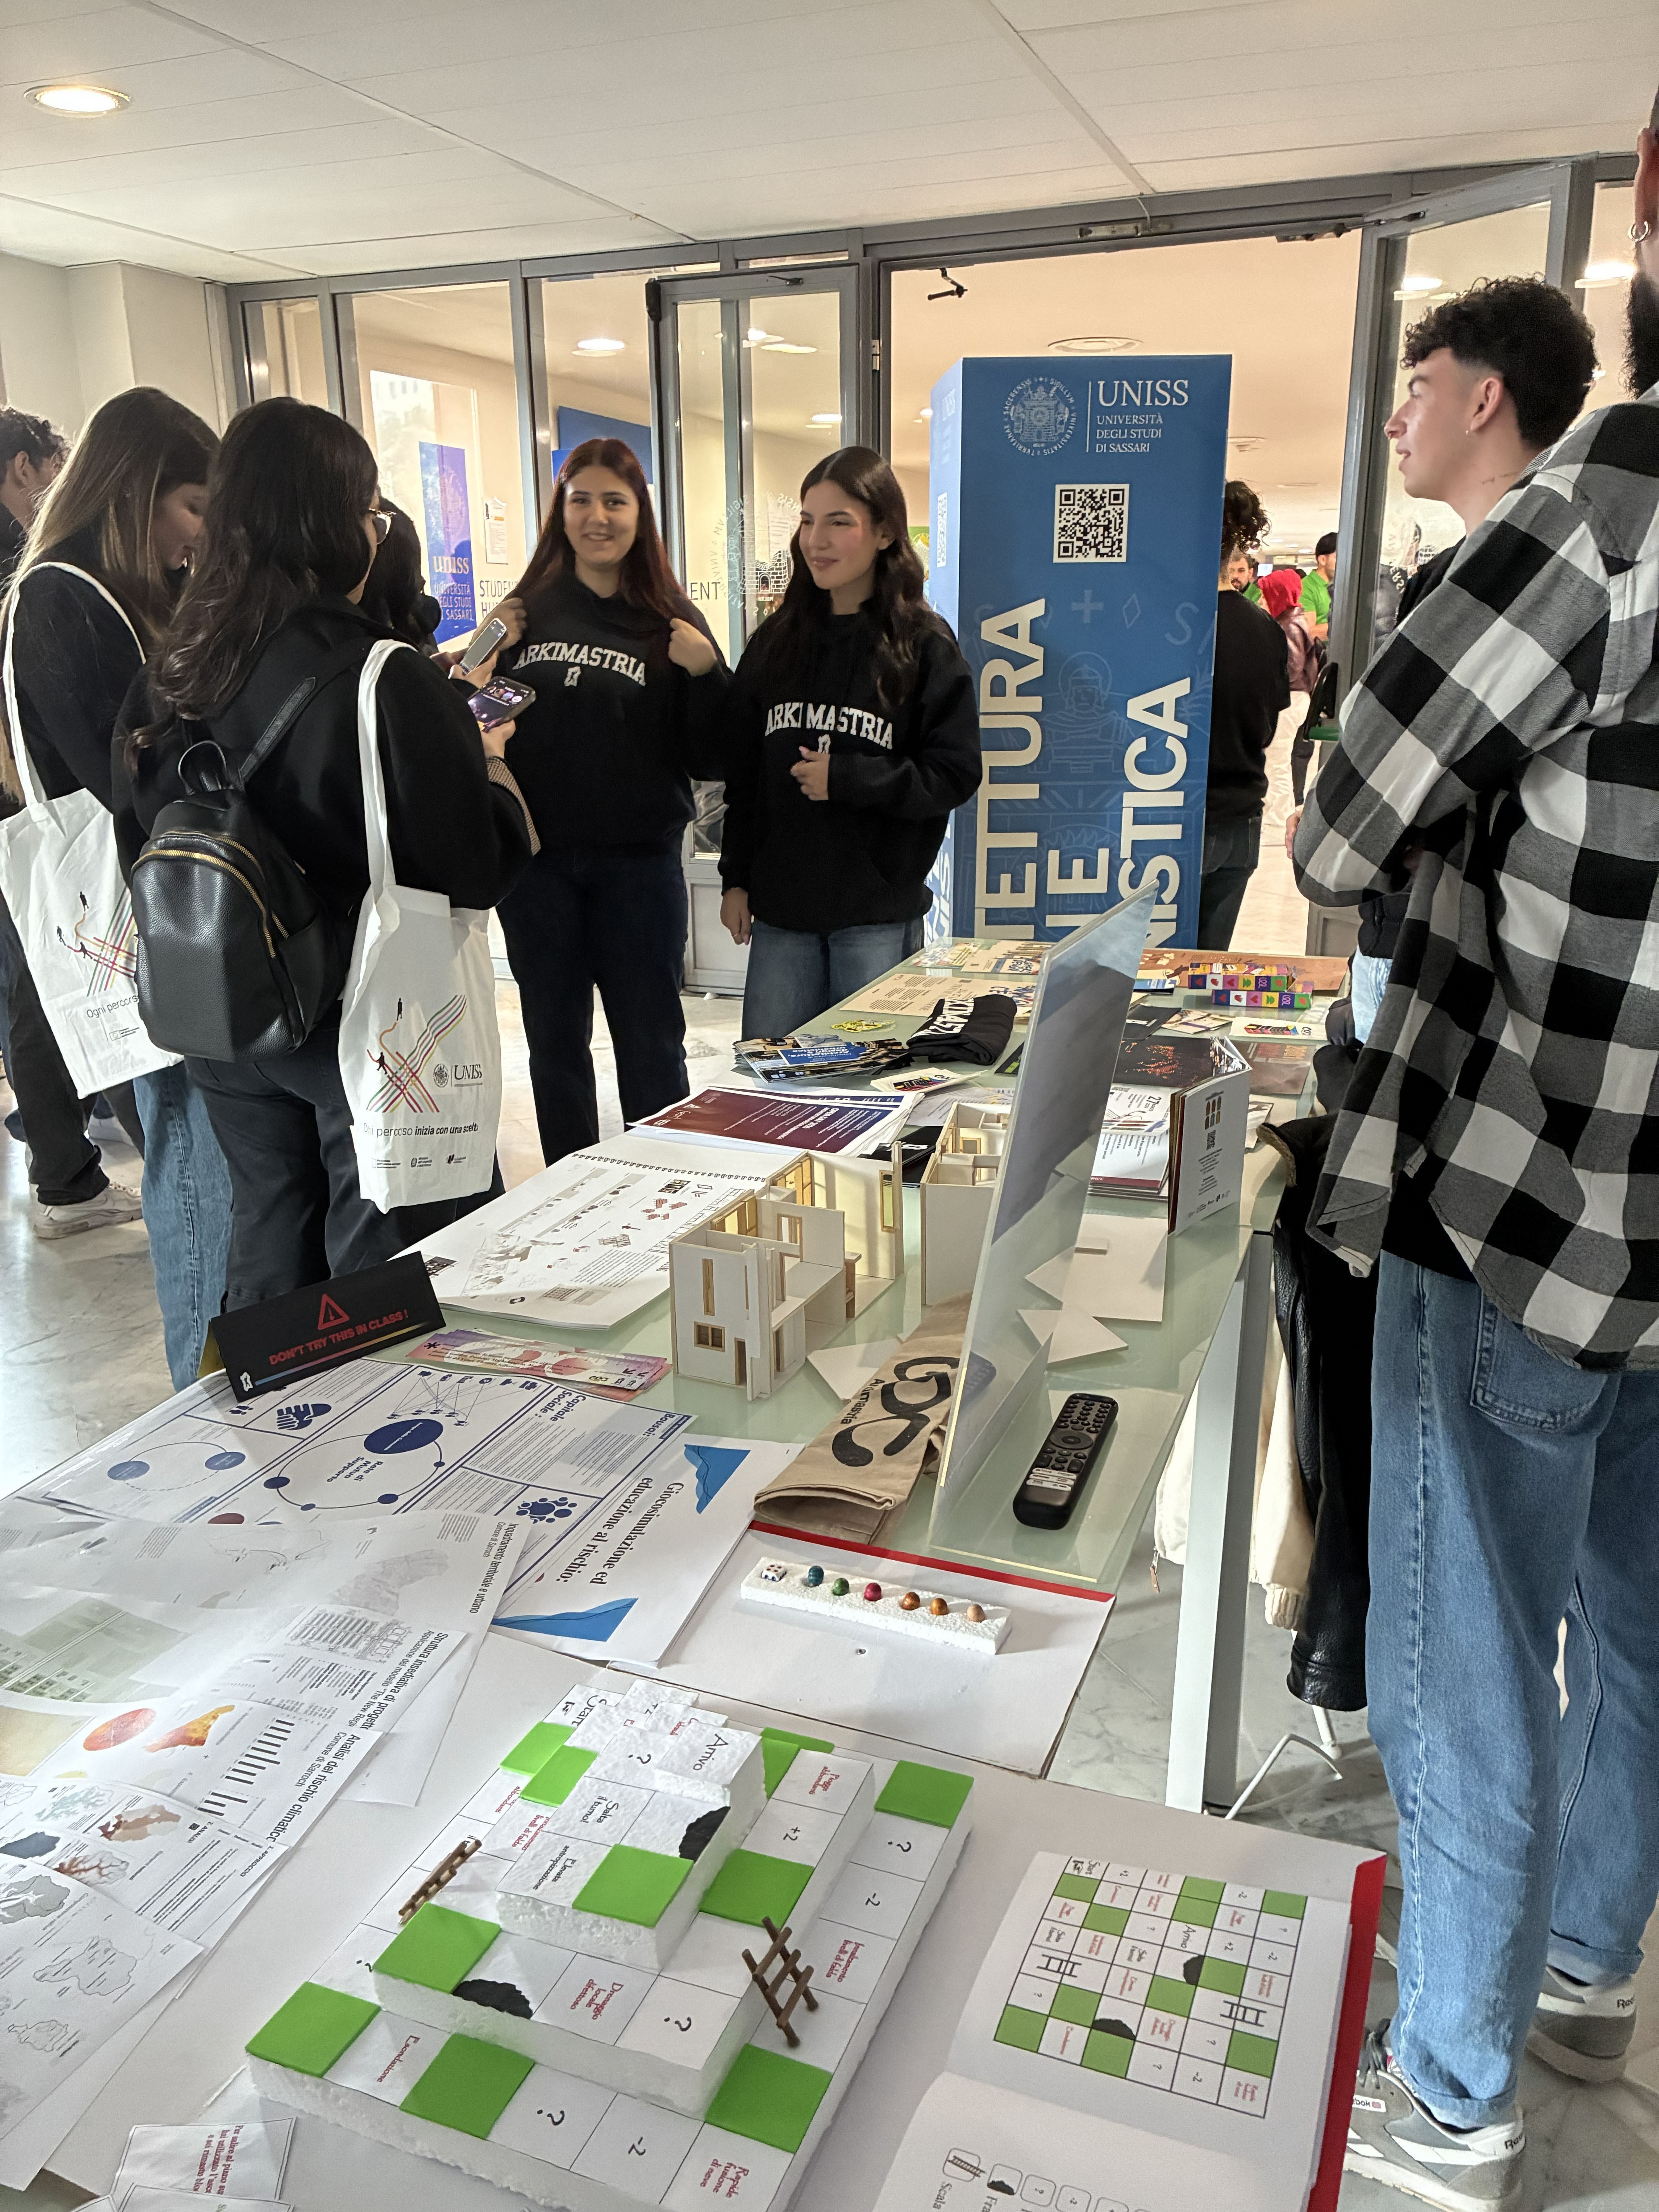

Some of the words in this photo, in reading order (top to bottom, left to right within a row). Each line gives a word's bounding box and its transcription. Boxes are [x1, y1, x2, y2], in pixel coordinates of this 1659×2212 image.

[1098, 379, 1189, 407] UNISS
[1097, 412, 1163, 425] UNIVERSITÀ
[1096, 428, 1128, 439] DEGLI
[1130, 428, 1162, 438] STUDI
[1096, 443, 1107, 453] DI
[1109, 442, 1150, 453] SASSARI
[434, 582, 471, 595] UNIVERSITÀ
[454, 597, 472, 608] STUDI
[512, 641, 646, 687] ARKIMASTRIA
[764, 702, 893, 750] ARKIMASTRIA
[974, 598, 1046, 939] TETTURA
[86, 1007, 106, 1019] Ogni
[106, 994, 140, 1015] percors
[414, 1125, 434, 1135] inizia
[436, 1126, 448, 1135] con
[449, 1125, 463, 1134] una
[269, 1345, 305, 1365] DON'T
[307, 1338, 327, 1353] TRY
[329, 1328, 355, 1345] THIS
[356, 1324, 368, 1336] IN
[369, 1311, 402, 1331] CLASS
[540, 1390, 572, 1413] Sociale
[550, 1395, 586, 1422] Capitale
[642, 1413, 676, 1437] Bousai:
[326, 1456, 365, 1482] Supporto
[344, 1460, 372, 1479] Mutuo
[363, 1460, 383, 1474] Rete
[601, 1477, 654, 1530] educazione
[592, 1531, 609, 1544] al
[604, 1482, 685, 1571] Giocosimulazione
[493, 1523, 519, 1560] Inquadramento
[481, 1561, 502, 1588] territoriale
[556, 1543, 599, 1583] rischio:
[589, 1571, 608, 1585] ed
[469, 1593, 486, 1613] urbano
[405, 1630, 434, 1659] Applicazione
[418, 1632, 449, 1659] Struttura
[397, 1657, 410, 1668] del
[391, 1656, 429, 1695] insediativa
[361, 1698, 377, 1712] New
[386, 1693, 397, 1702] di
[321, 1731, 347, 1756] Comune
[335, 1734, 361, 1760] Analisi
[692, 1733, 729, 1771] Arrivo
[316, 1754, 326, 1764] di
[325, 1759, 341, 1773] del
[299, 1770, 329, 1803] rischio
[581, 1802, 604, 1824] turno!
[596, 1799, 620, 1824] Salta
[783, 1826, 801, 1842] +2
[551, 1857, 577, 1883] Elevata
[932, 2181, 953, 2210] Scala
[982, 2196, 998, 2212] Fra
